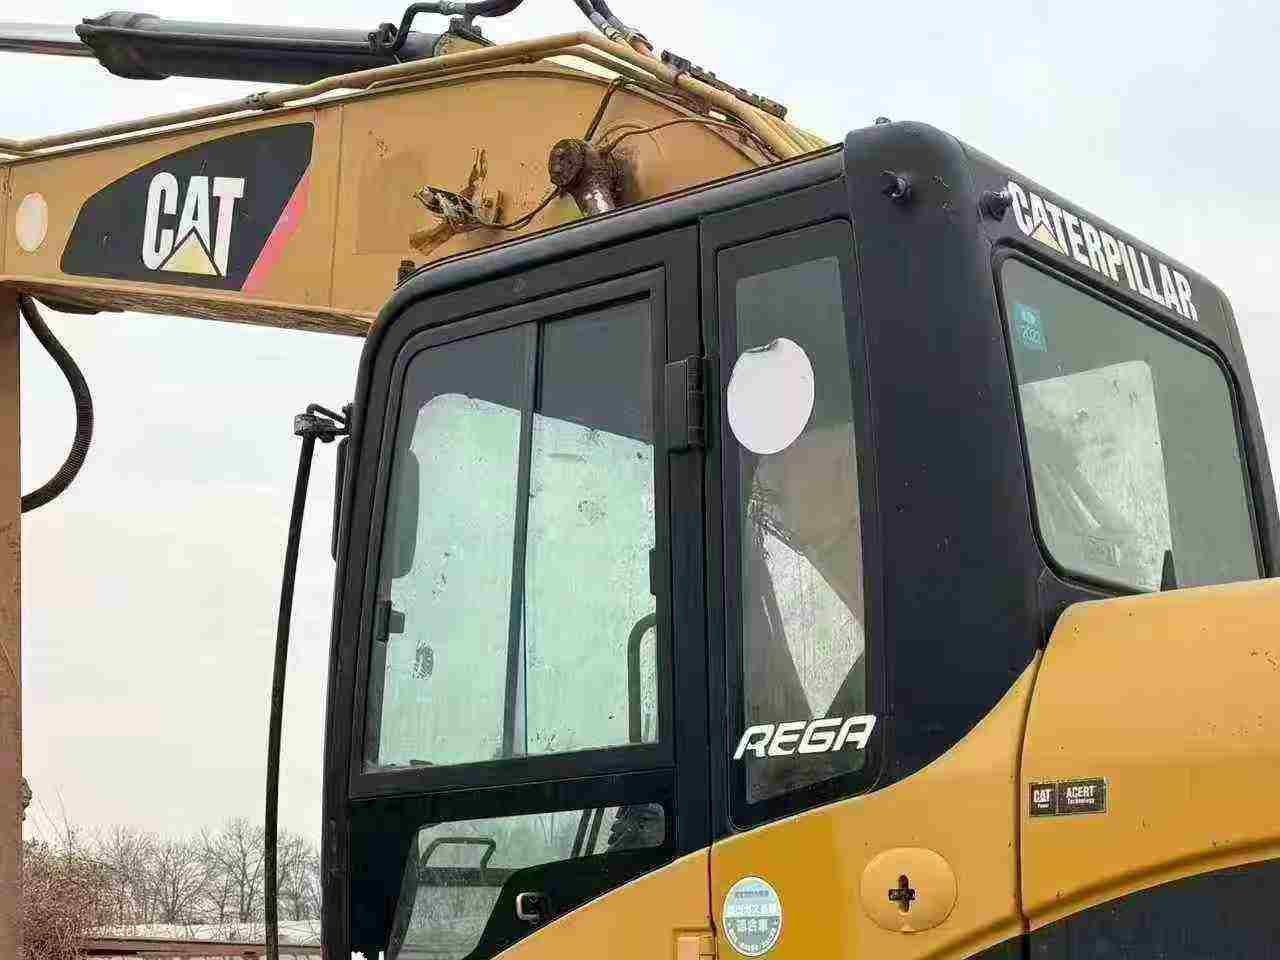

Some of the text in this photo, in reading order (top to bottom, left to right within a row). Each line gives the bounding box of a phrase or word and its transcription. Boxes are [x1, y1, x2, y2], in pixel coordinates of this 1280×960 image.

[142, 171, 245, 277] CAT
[1007, 180, 1199, 322] CATERPILLAR
[732, 713, 877, 760] REGA
[1033, 785, 1097, 803] CAT ACERT
